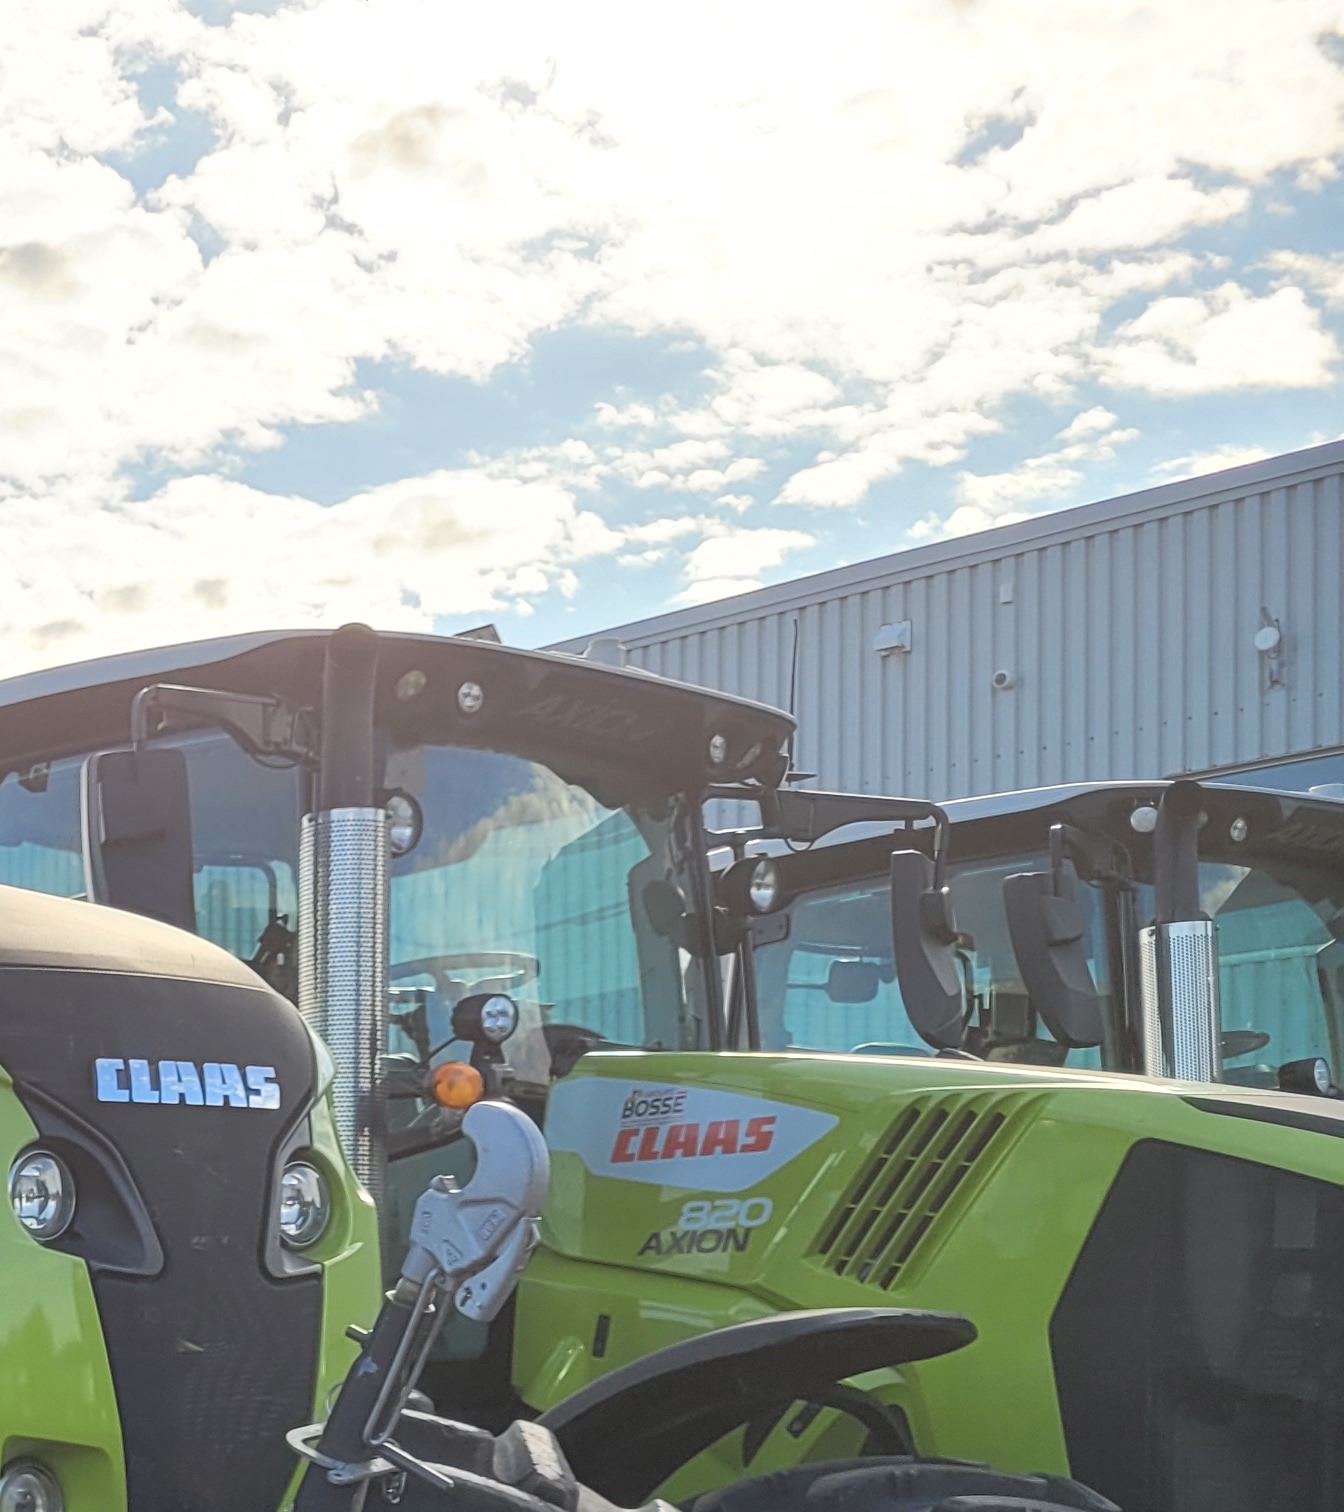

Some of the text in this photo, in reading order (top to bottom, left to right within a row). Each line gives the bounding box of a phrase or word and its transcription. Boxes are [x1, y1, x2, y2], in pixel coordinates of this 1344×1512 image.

[95, 1058, 281, 1110] CLAAS
[621, 1095, 687, 1119] BOSSE
[610, 1116, 776, 1163] CLAAS
[678, 1197, 773, 1230] 820
[638, 1228, 752, 1256] AXION
